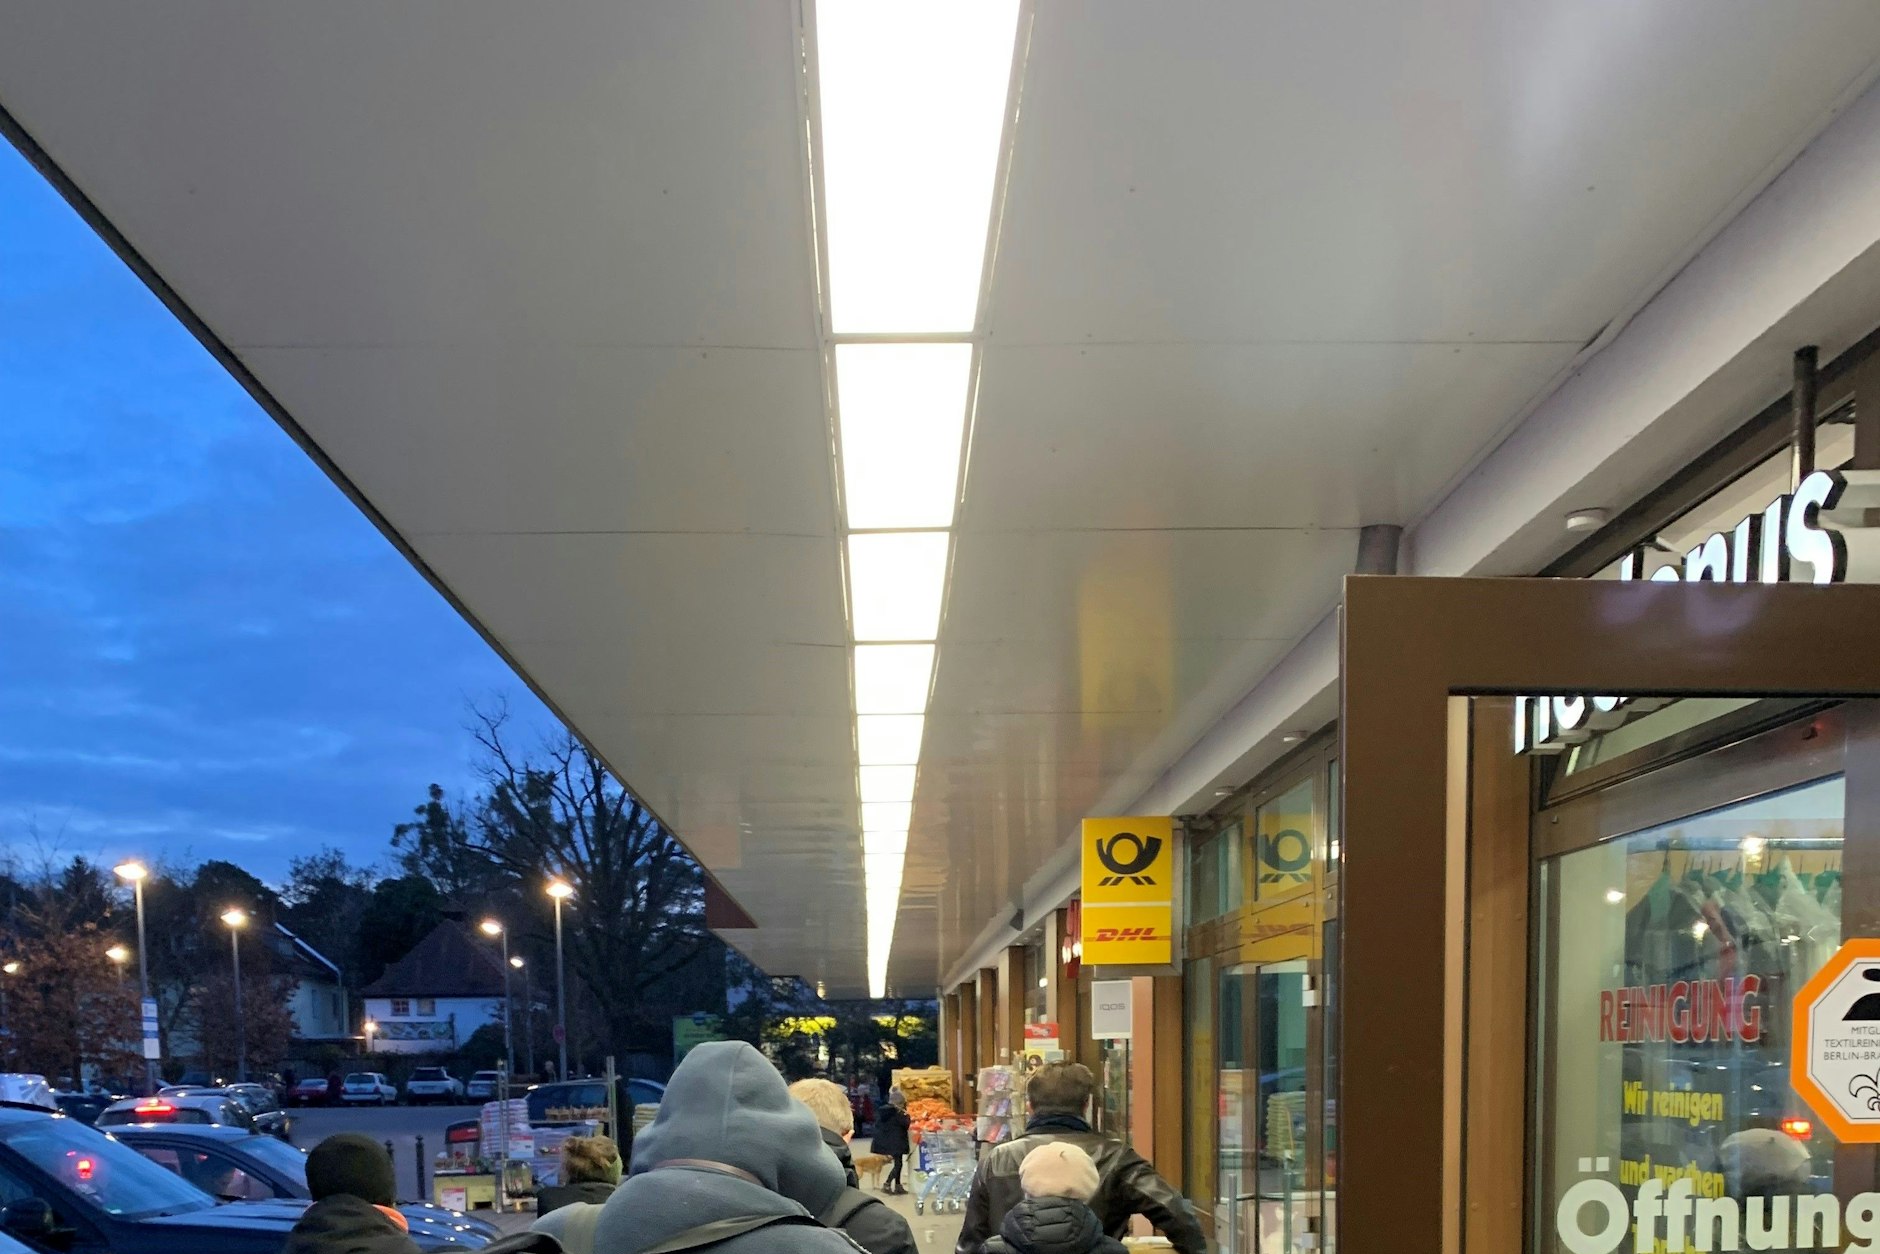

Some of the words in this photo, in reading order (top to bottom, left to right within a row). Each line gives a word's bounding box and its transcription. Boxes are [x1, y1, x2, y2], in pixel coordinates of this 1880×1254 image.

[1095, 927, 1158, 942] DHL
[1600, 974, 1761, 1044] REINIGUNG
[1624, 1081, 1648, 1115] Wir
[1653, 1082, 1724, 1127] reinigen
[1620, 1154, 1650, 1187] und
